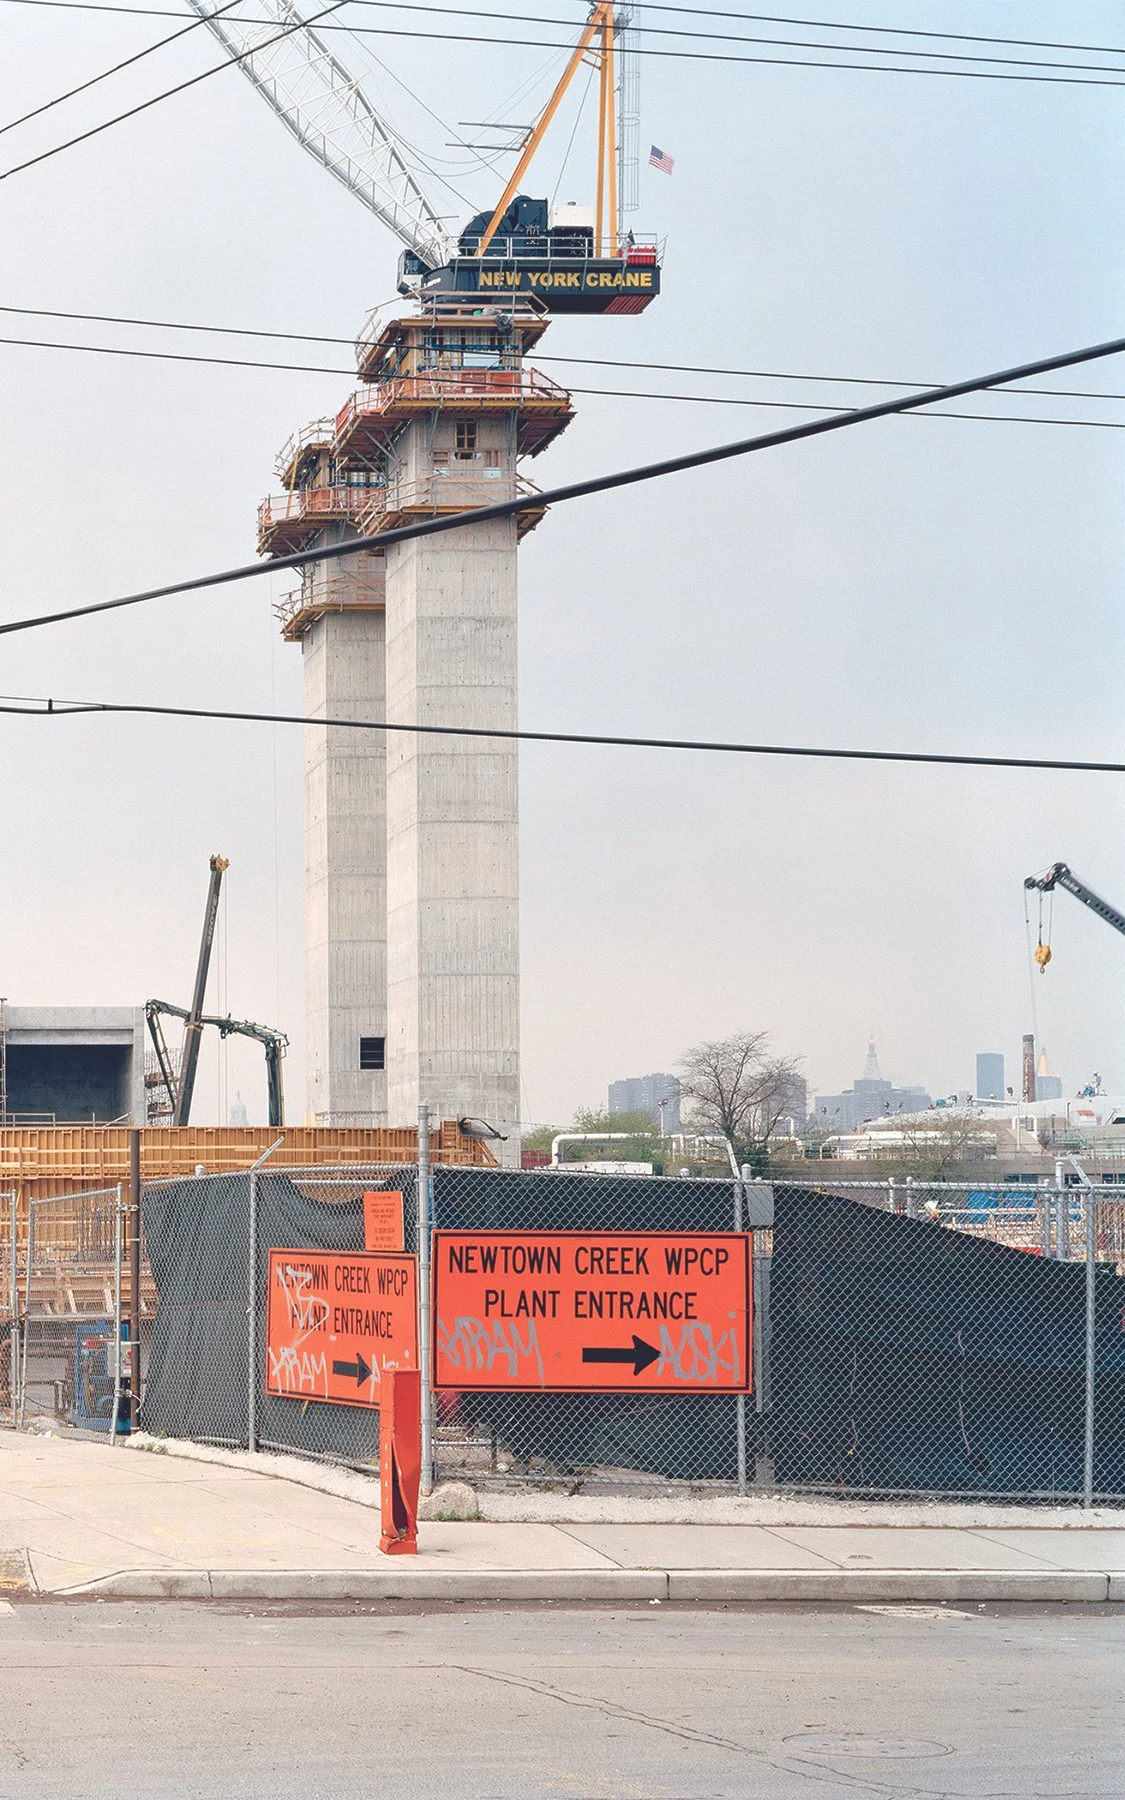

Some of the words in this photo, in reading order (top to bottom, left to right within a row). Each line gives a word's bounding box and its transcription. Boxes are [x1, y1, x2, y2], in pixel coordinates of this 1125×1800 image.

[479, 272, 521, 286] NEW
[527, 272, 580, 287] YORK
[586, 272, 652, 287] CRANE
[448, 1245, 562, 1275] NEWTOWN
[575, 1246, 650, 1276] CREEK
[664, 1247, 729, 1276] WPCP
[334, 1265, 371, 1294] CREEK
[377, 1267, 408, 1296] WPCP
[484, 1289, 561, 1318] PLANT
[574, 1290, 698, 1320] ENTRANCE
[291, 1303, 327, 1332] PNT
[334, 1307, 393, 1339] ENTRANCE
